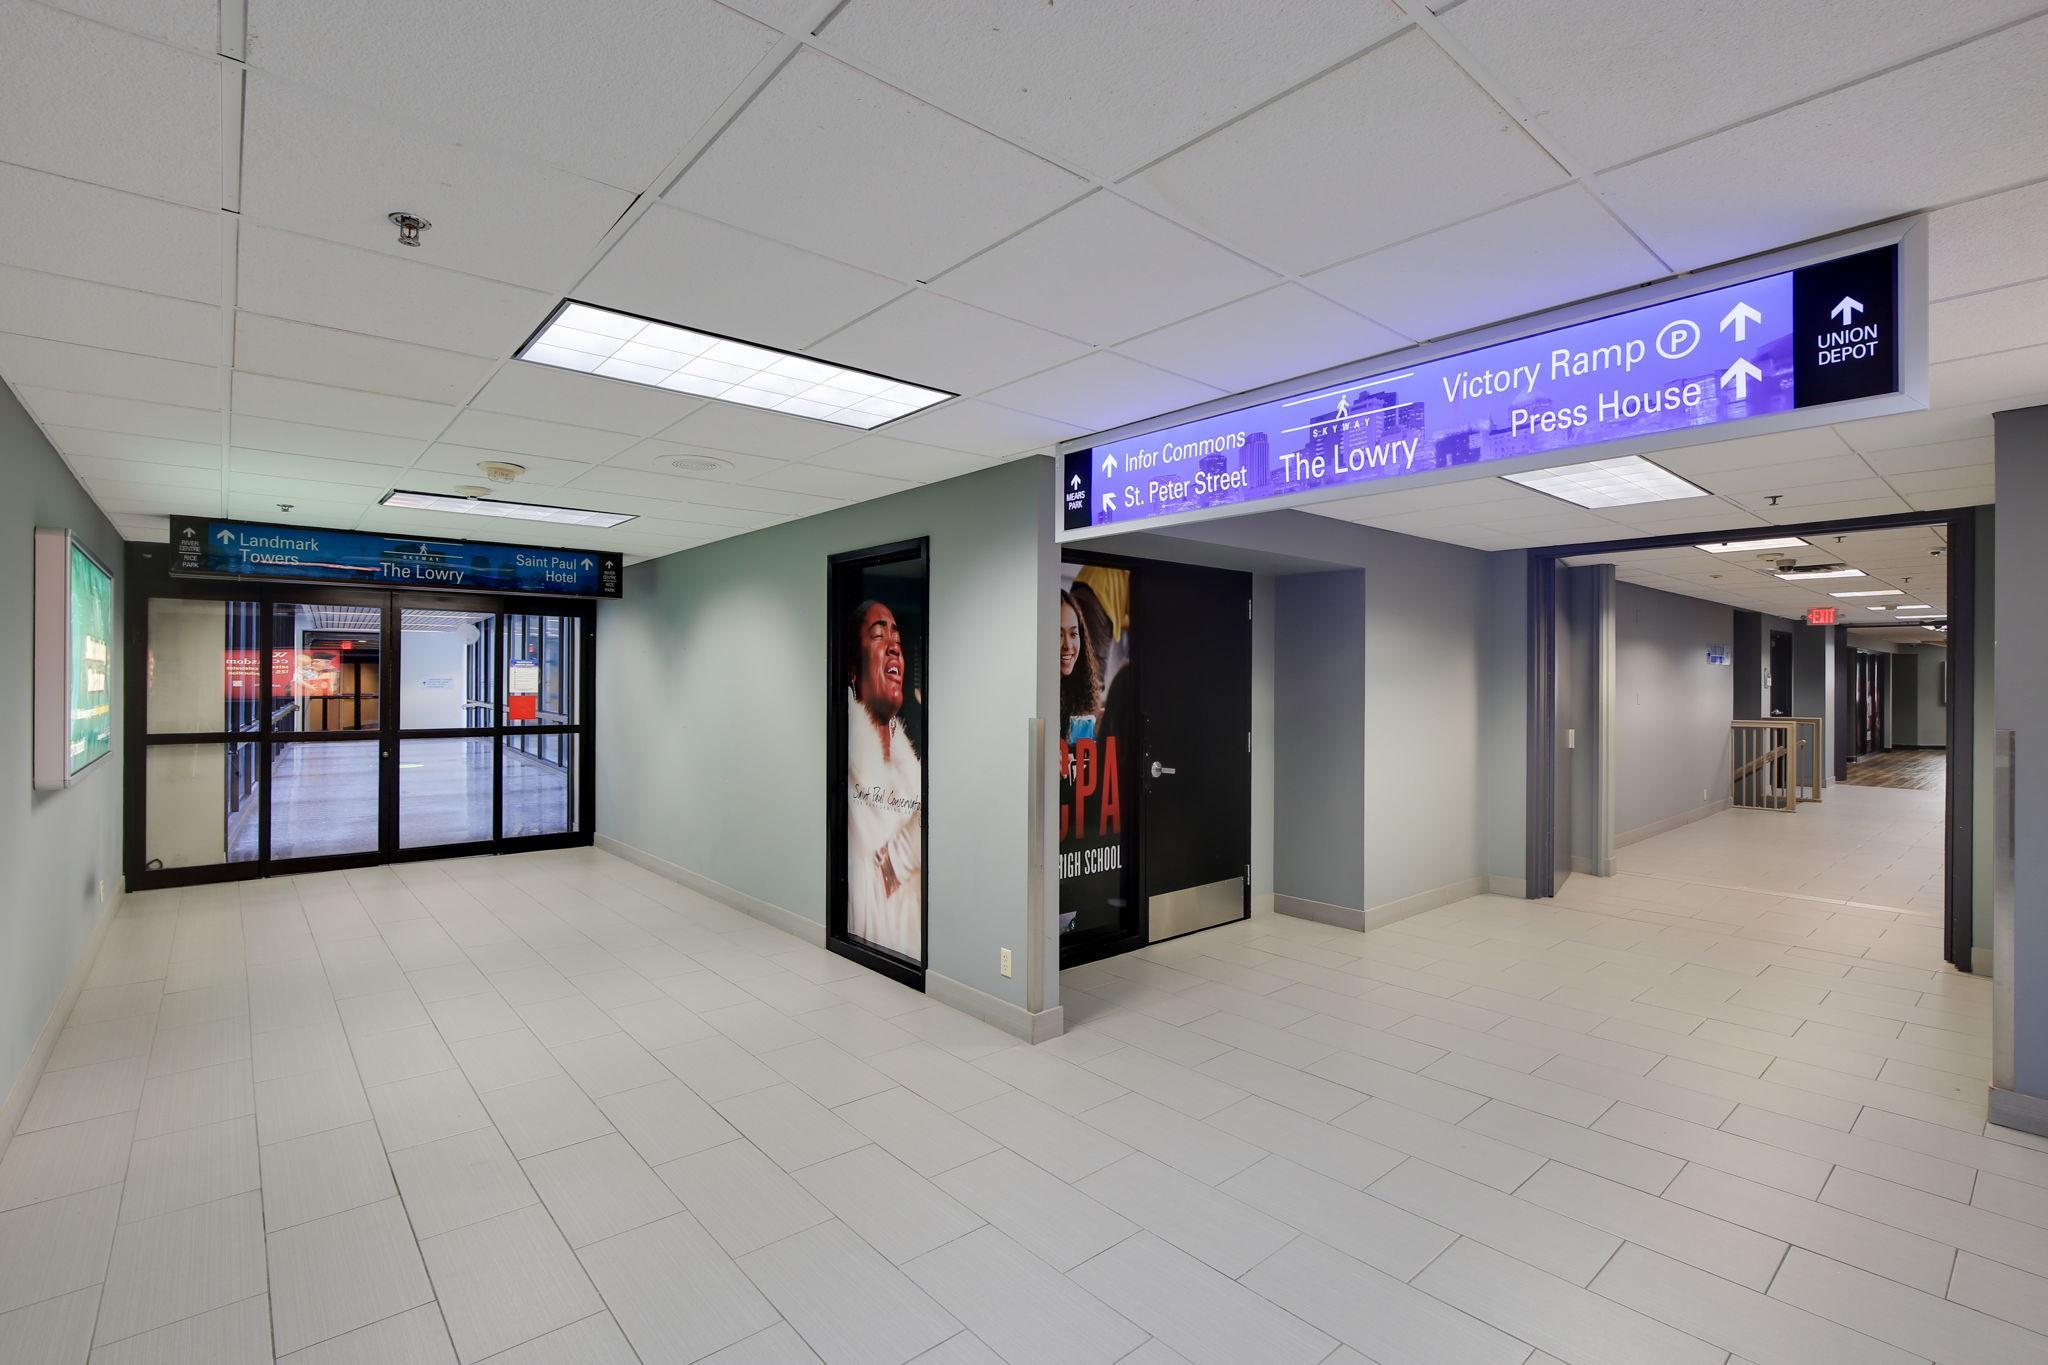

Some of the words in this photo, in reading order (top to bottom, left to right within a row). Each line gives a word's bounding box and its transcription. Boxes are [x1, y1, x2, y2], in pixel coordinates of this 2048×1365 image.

[1818, 323, 1879, 349] UNION
[1818, 341, 1879, 366] DEPOT
[1442, 361, 1541, 402] Victory
[1550, 338, 1645, 380] Ramp
[1511, 404, 1588, 438] Press
[1598, 381, 1701, 423] House
[1312, 417, 1370, 438] SKYWAY
[1124, 450, 1159, 472] Infor
[1162, 430, 1246, 464] Commons
[1279, 452, 1326, 483] The
[1333, 437, 1418, 474] Lowry
[1066, 490, 1086, 501] MEARS
[1124, 485, 1145, 507] St.
[1149, 480, 1190, 502] Peter
[1194, 465, 1247, 495] Street
[1068, 500, 1083, 510] PARK
[240, 532, 319, 552] Landmark
[239, 548, 299, 565] Towers
[516, 553, 548, 568] Saint
[551, 556, 577, 570] Paul
[379, 561, 411, 578] The
[416, 564, 464, 585] Lowry
[546, 570, 577, 584] Hotel
[1812, 608, 1835, 624] EXIT
[1084, 845, 1123, 875] SCHOOL
